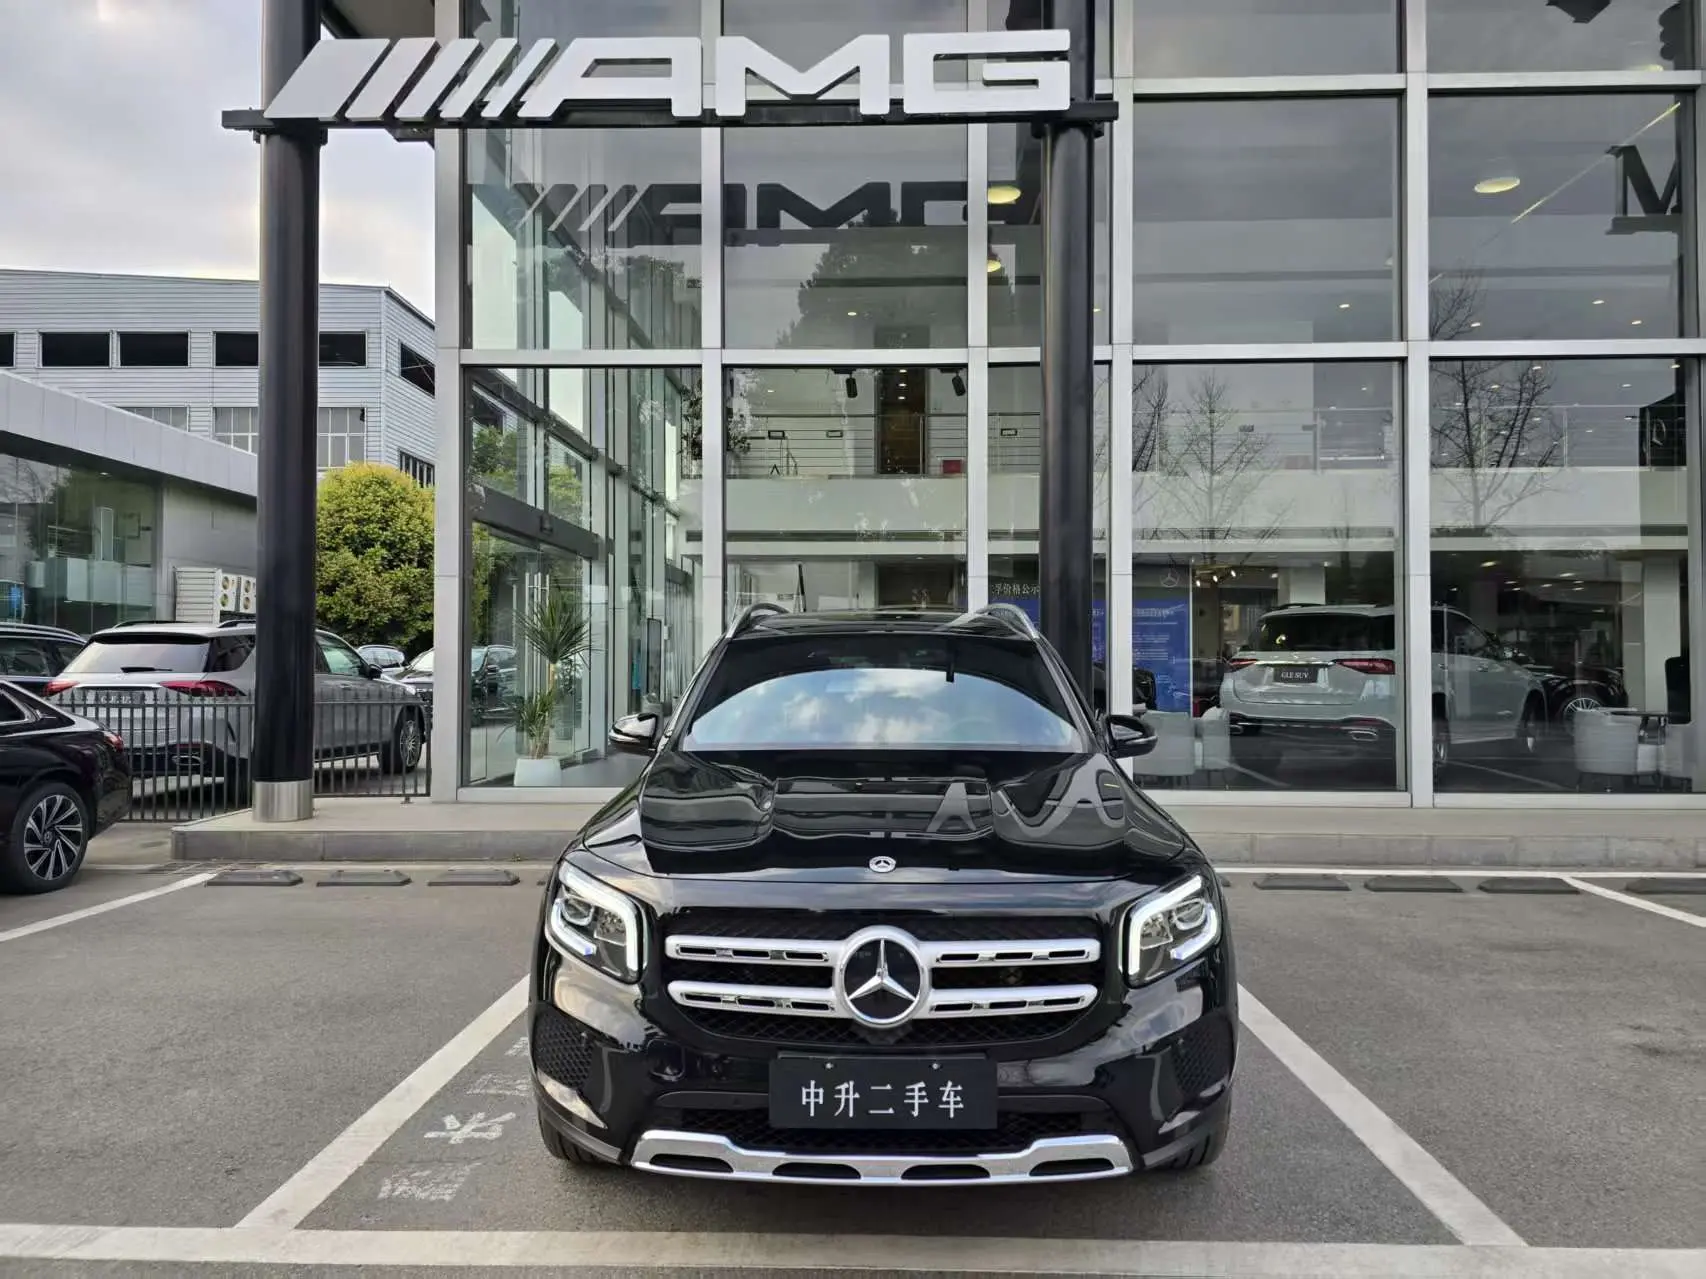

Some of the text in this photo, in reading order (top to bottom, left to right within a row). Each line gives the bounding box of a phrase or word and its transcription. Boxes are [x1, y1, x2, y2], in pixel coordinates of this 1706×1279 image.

[516, 30, 1072, 118] AMG
[801, 1079, 965, 1119] 中升二手车
